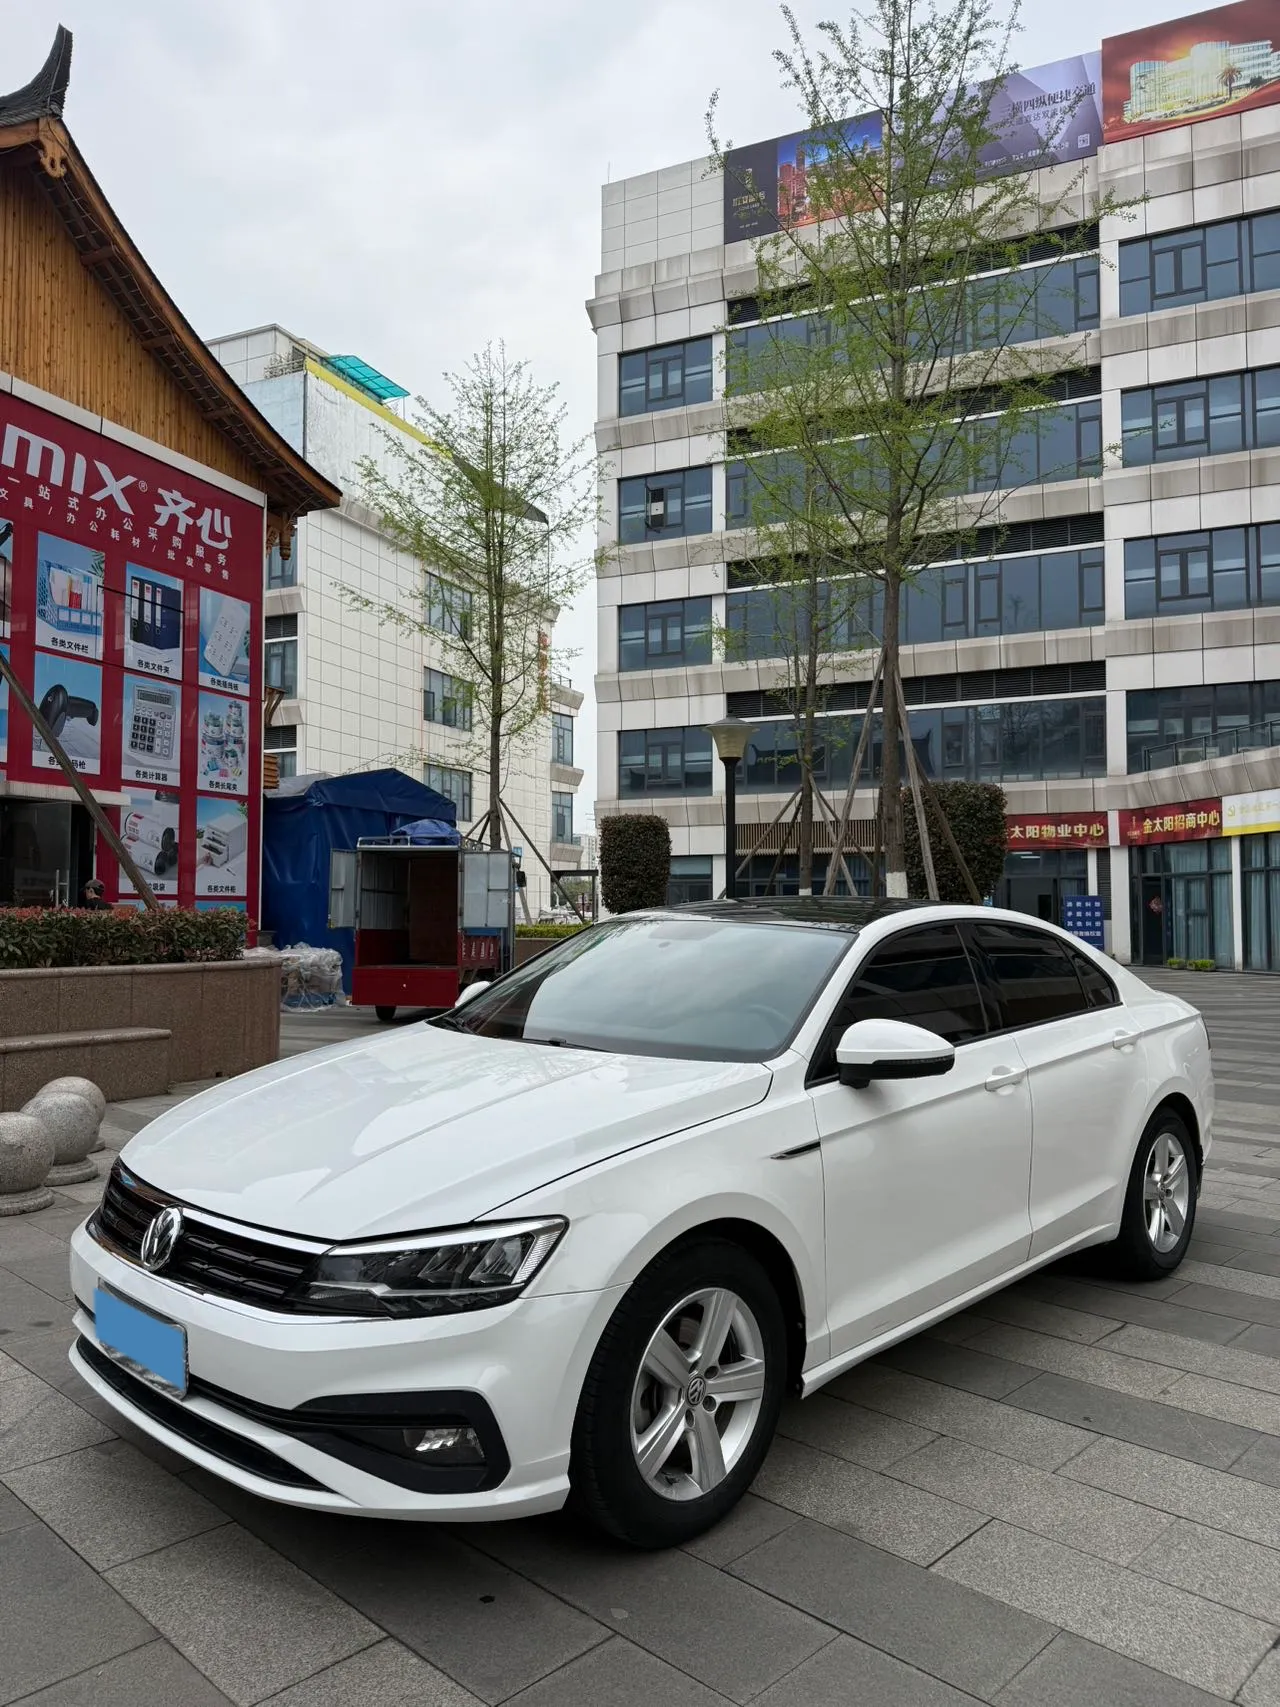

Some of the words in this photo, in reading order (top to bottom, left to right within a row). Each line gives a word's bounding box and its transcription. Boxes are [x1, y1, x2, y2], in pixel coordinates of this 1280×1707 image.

[154, 488, 233, 550] 齐心
[51, 637, 89, 655] 各类文件栏
[137, 659, 170, 675] 各类文件夹
[135, 769, 168, 782] 各类计算器
[208, 780, 238, 792] 各类长尾夹
[1143, 809, 1220, 834] 金太阳招商中心
[1004, 823, 1104, 839] 太阳物业中心
